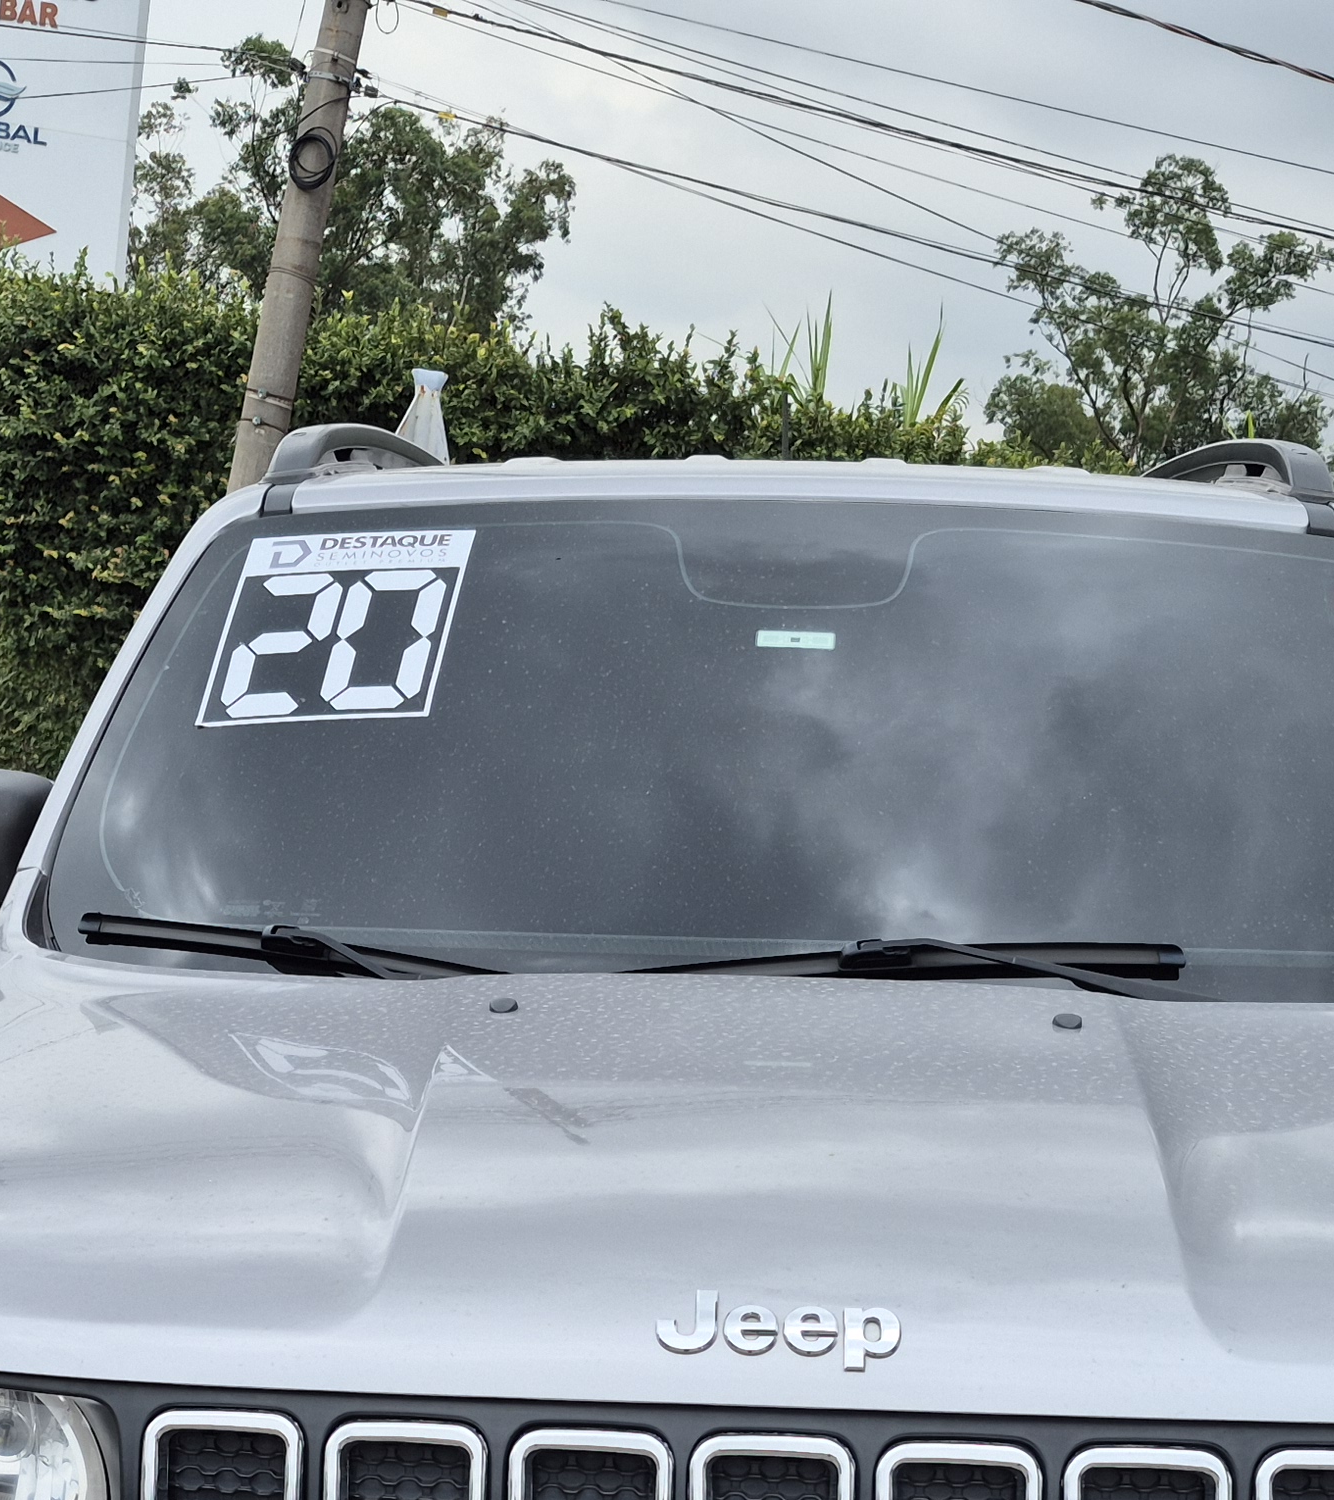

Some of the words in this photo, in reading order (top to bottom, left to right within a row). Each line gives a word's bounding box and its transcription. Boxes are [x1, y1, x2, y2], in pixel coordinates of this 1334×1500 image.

[316, 548, 447, 562] SEMINOVOS
[319, 533, 453, 550] DESTAQUE
[221, 569, 447, 718] 20
[655, 1289, 902, 1373] Jeep
